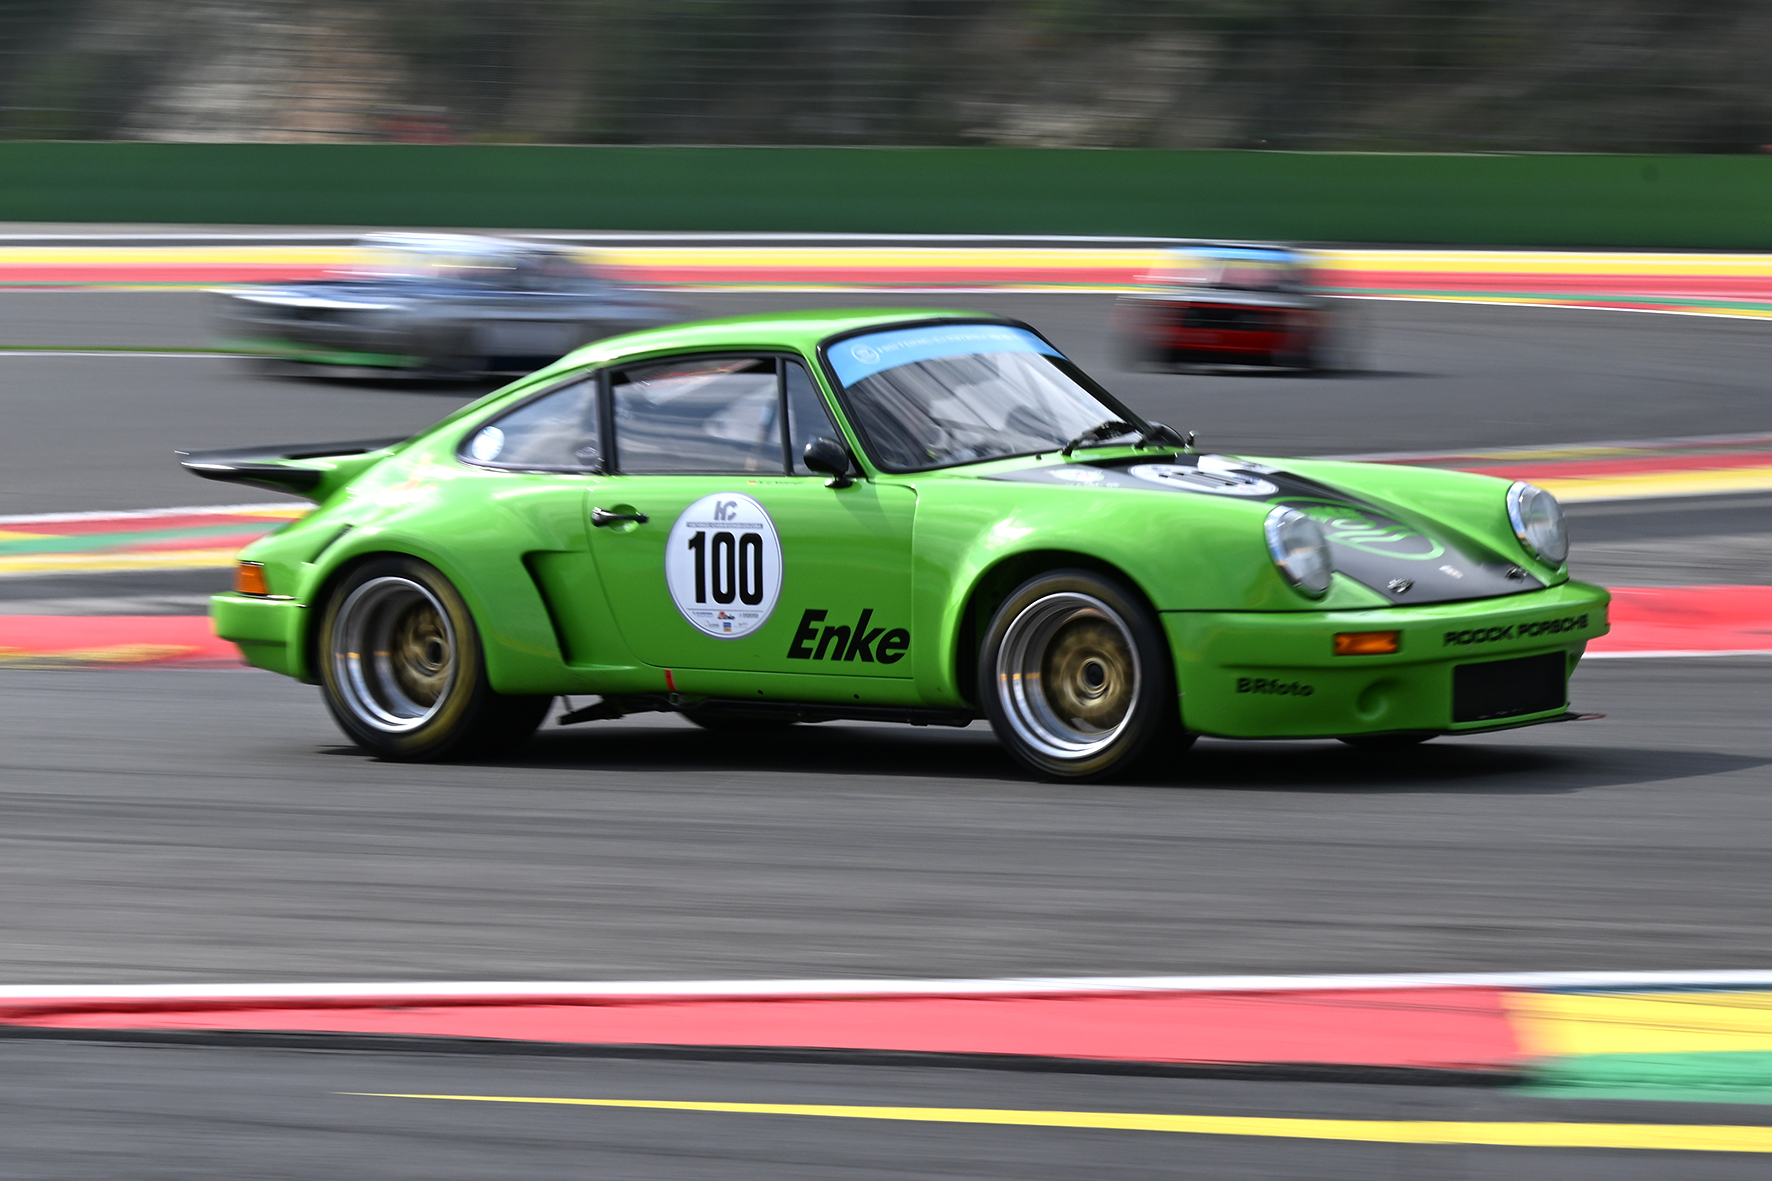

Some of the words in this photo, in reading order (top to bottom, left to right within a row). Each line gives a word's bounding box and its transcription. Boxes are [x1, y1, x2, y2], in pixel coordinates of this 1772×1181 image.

[688, 531, 764, 606] 100
[786, 608, 911, 665] Enke
[1516, 613, 1589, 639] PORSCHE
[1236, 677, 1316, 697] BRfoto
